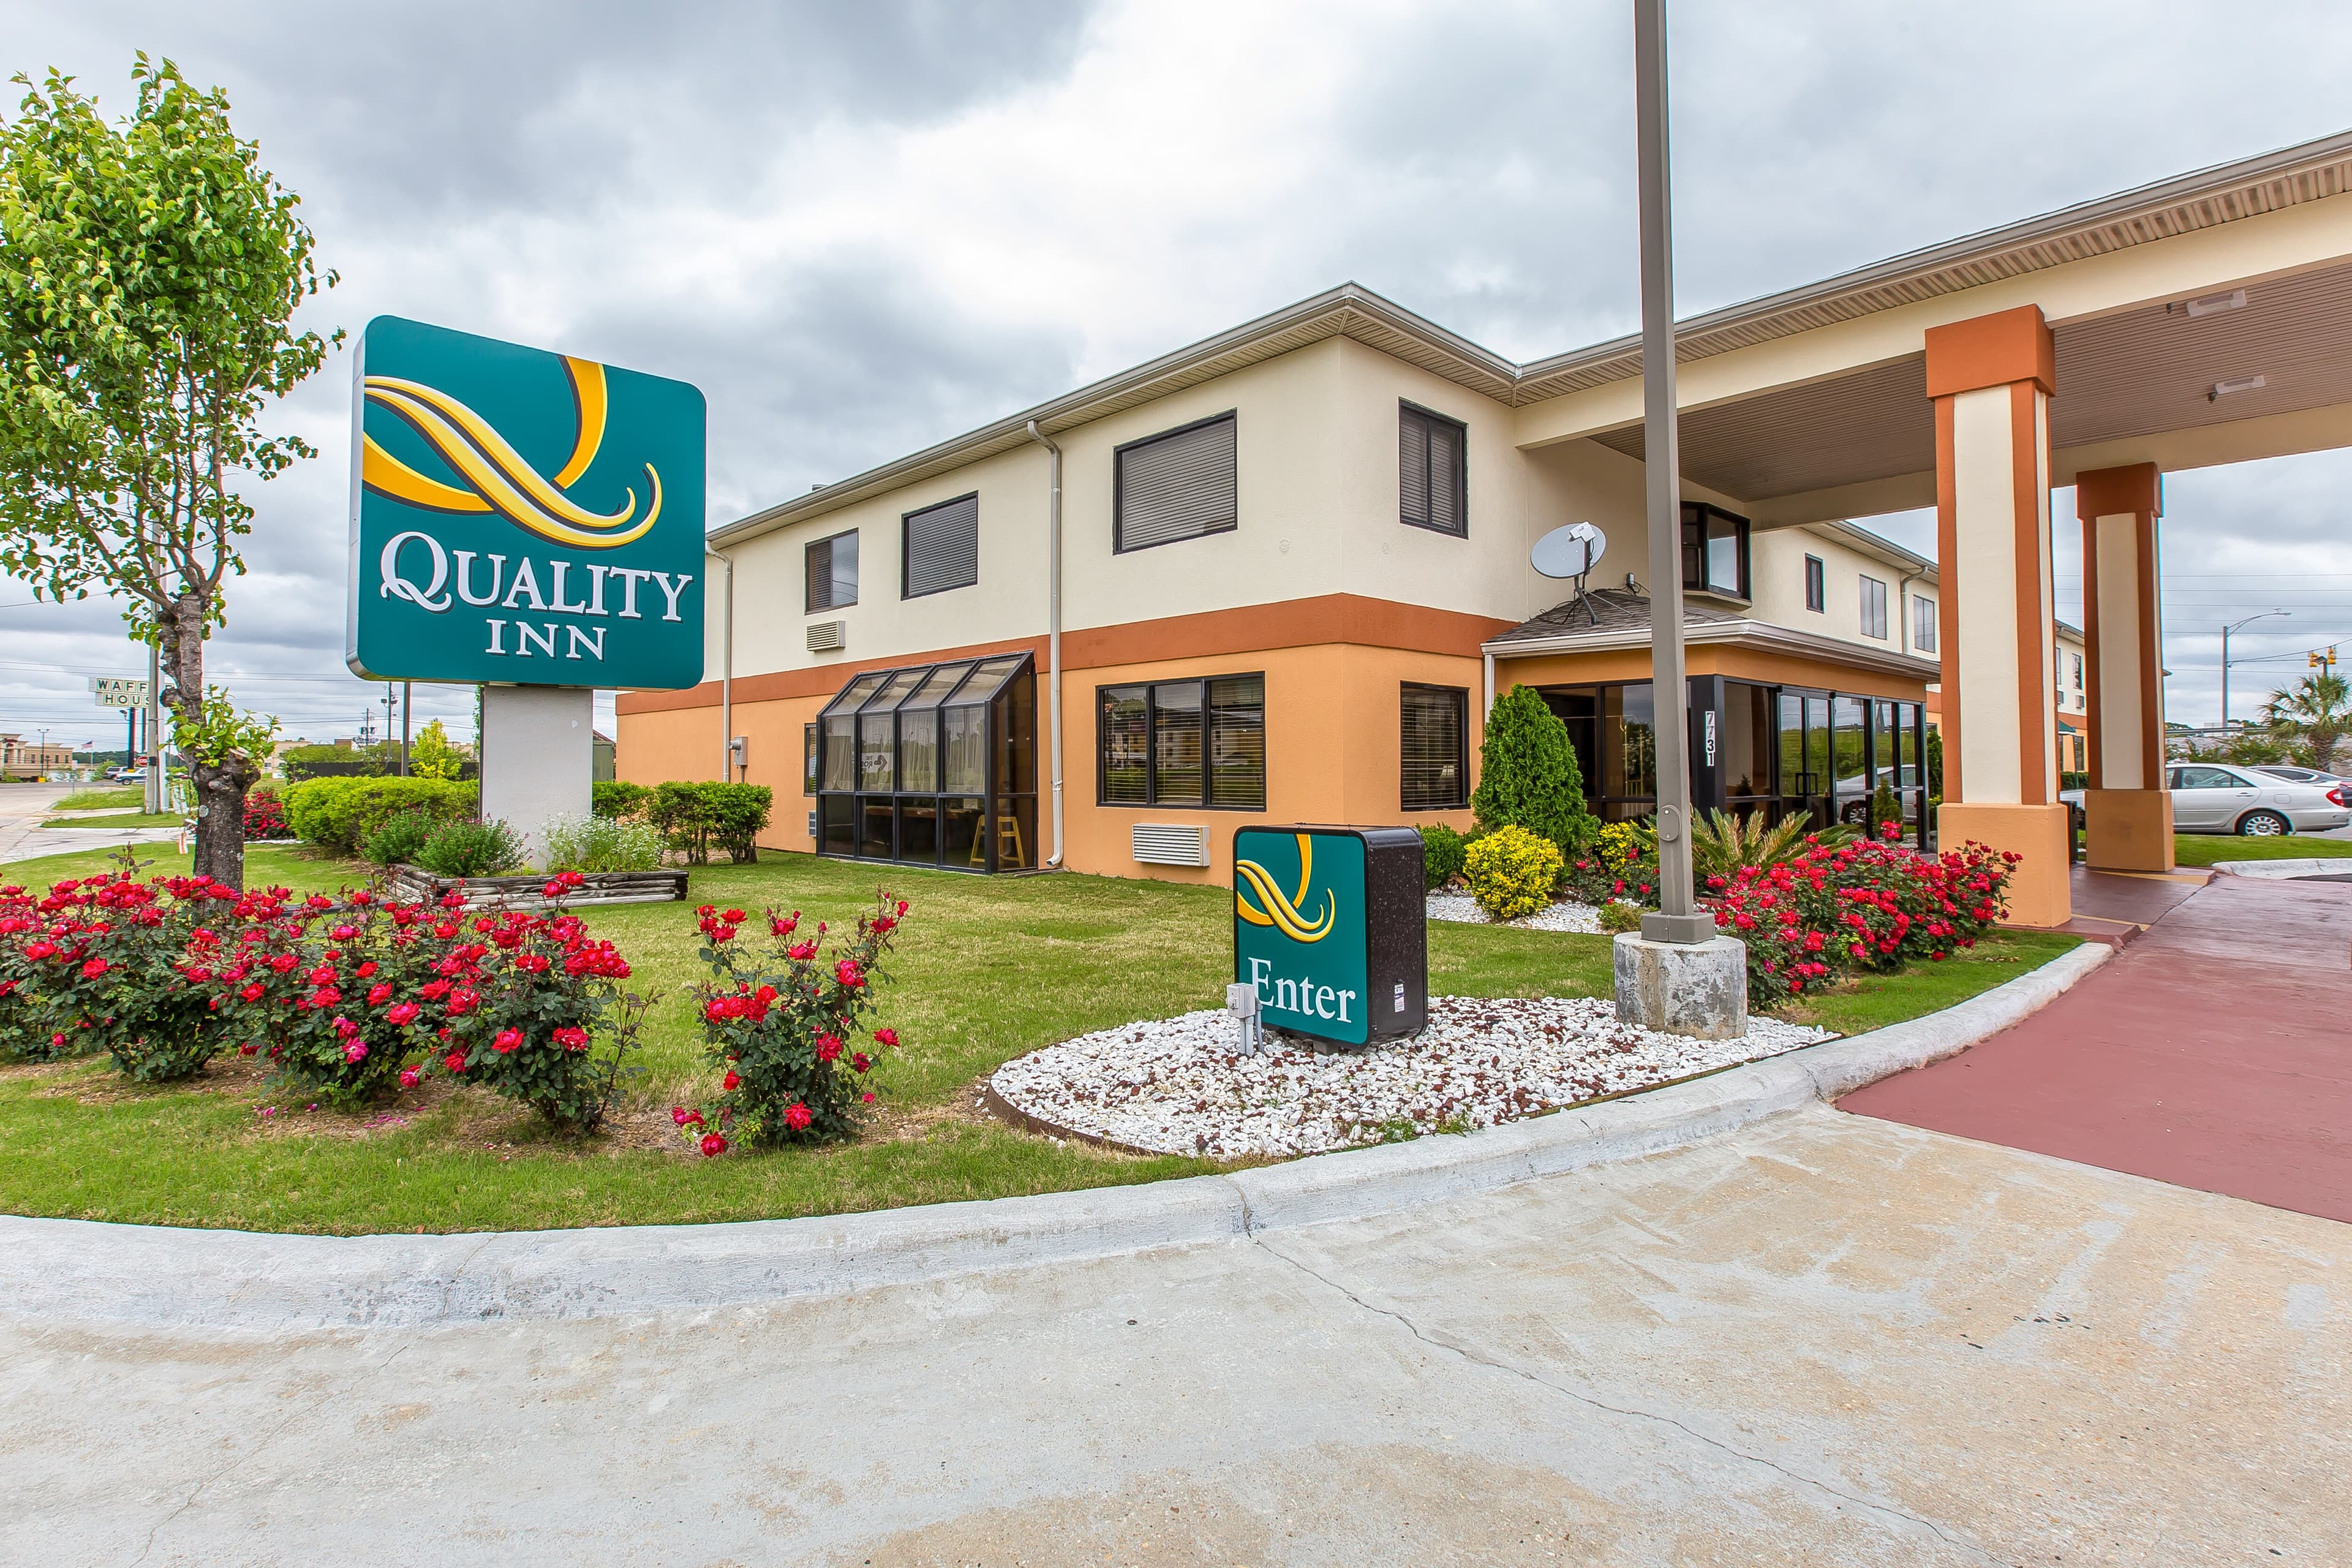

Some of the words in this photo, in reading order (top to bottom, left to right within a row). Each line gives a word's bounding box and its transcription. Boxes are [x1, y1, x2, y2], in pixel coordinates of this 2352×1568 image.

[380, 532, 693, 622] QUALITY
[486, 619, 606, 660] INN
[105, 694, 149, 705] HOU
[1248, 957, 1356, 1023] Enter
